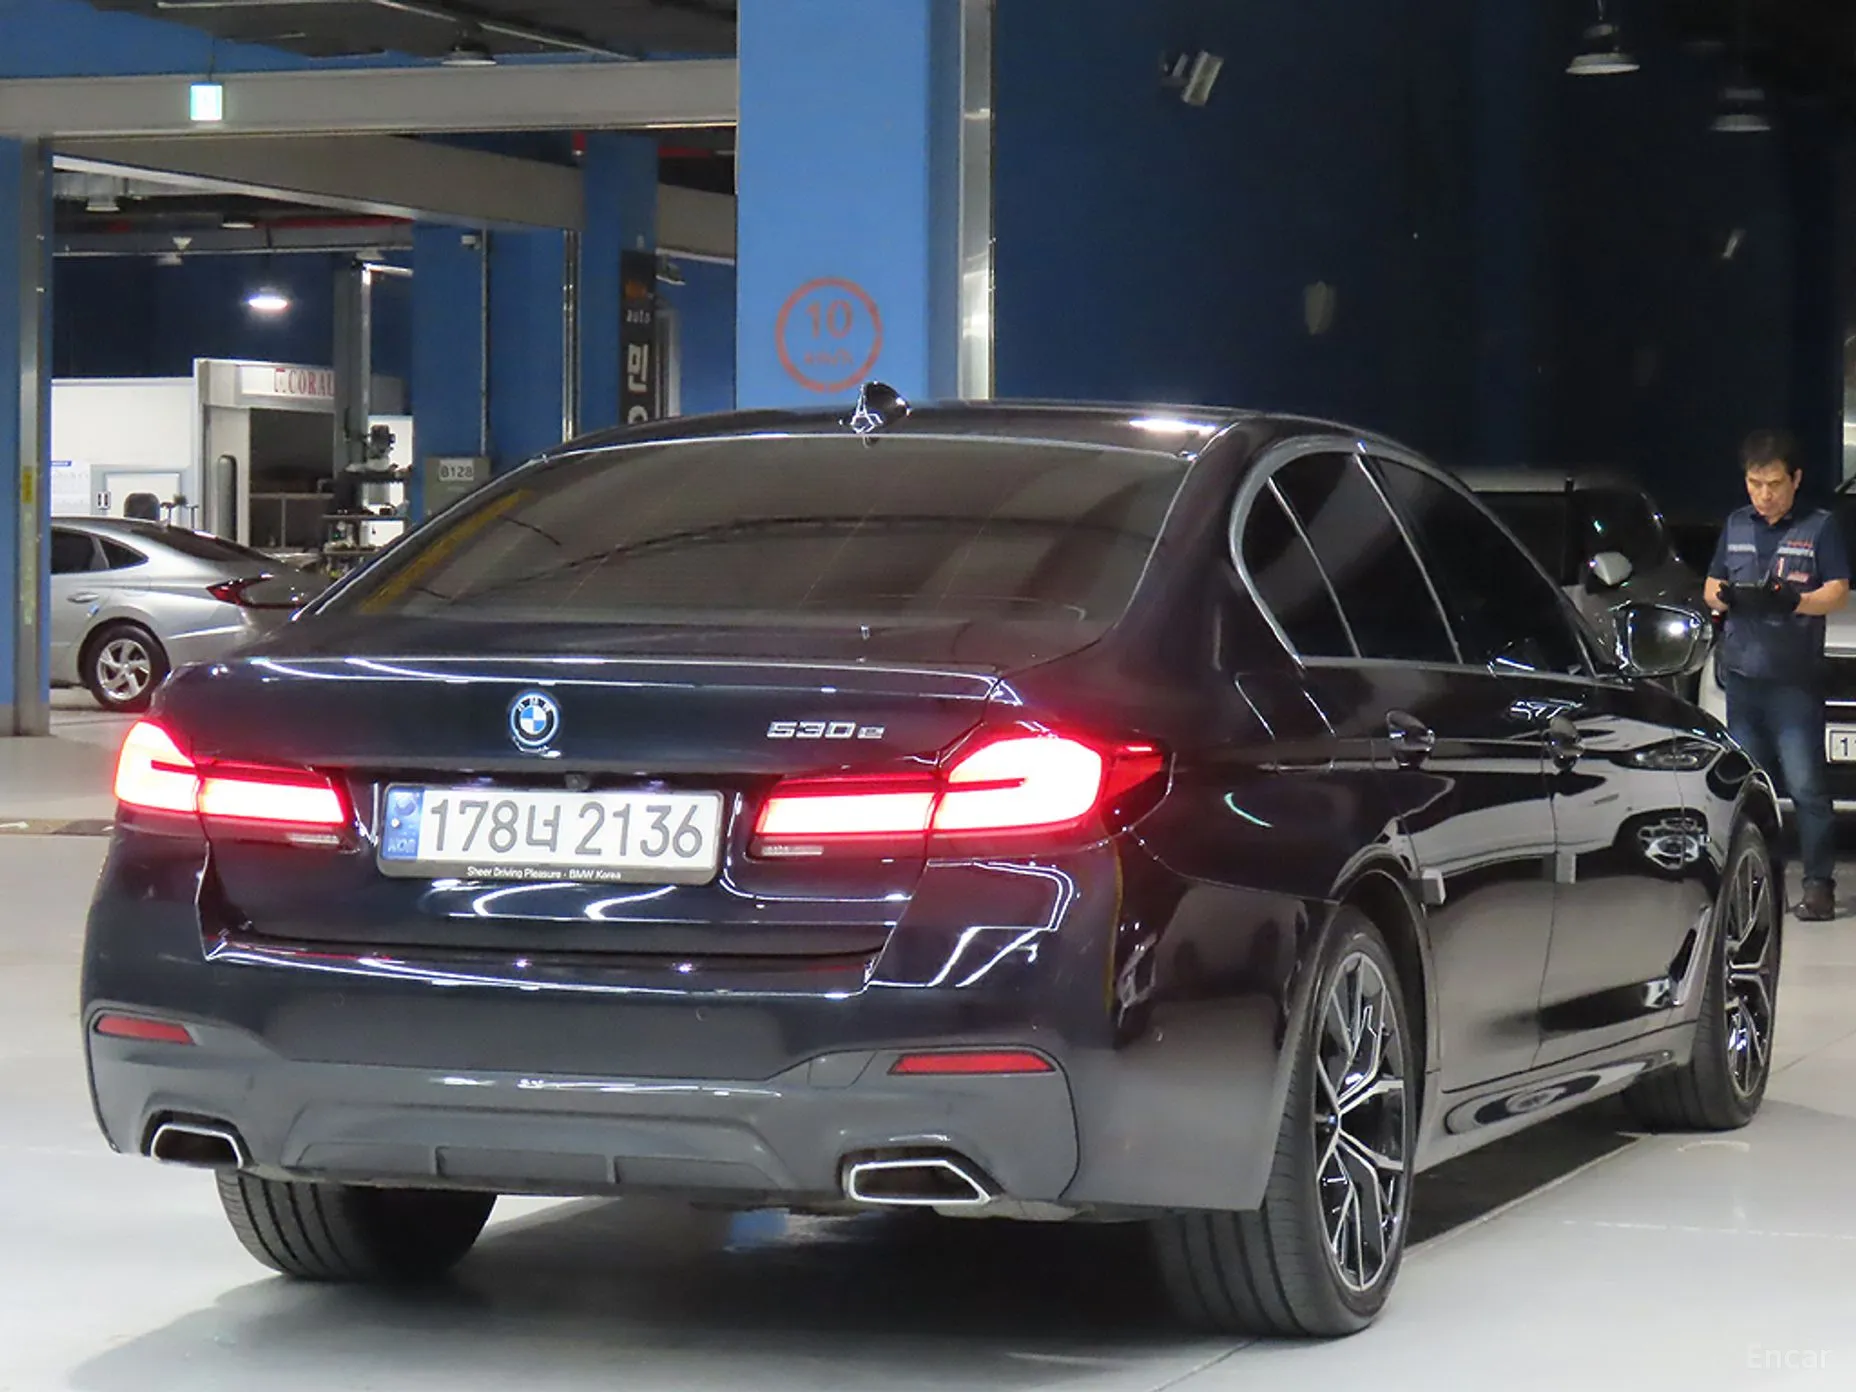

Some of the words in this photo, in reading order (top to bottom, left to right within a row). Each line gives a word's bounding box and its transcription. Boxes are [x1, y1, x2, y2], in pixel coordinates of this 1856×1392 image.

[626, 308, 651, 324] auto
[805, 299, 853, 339] 10
[1840, 736, 1856, 757] 1
[431, 799, 561, 854] 178너
[574, 802, 706, 859] 2136
[467, 865, 492, 877] Sheer
[494, 866, 522, 879] Driving
[524, 868, 562, 879] Pleasure
[569, 869, 595, 880] BMW
[596, 870, 622, 880] Korea
